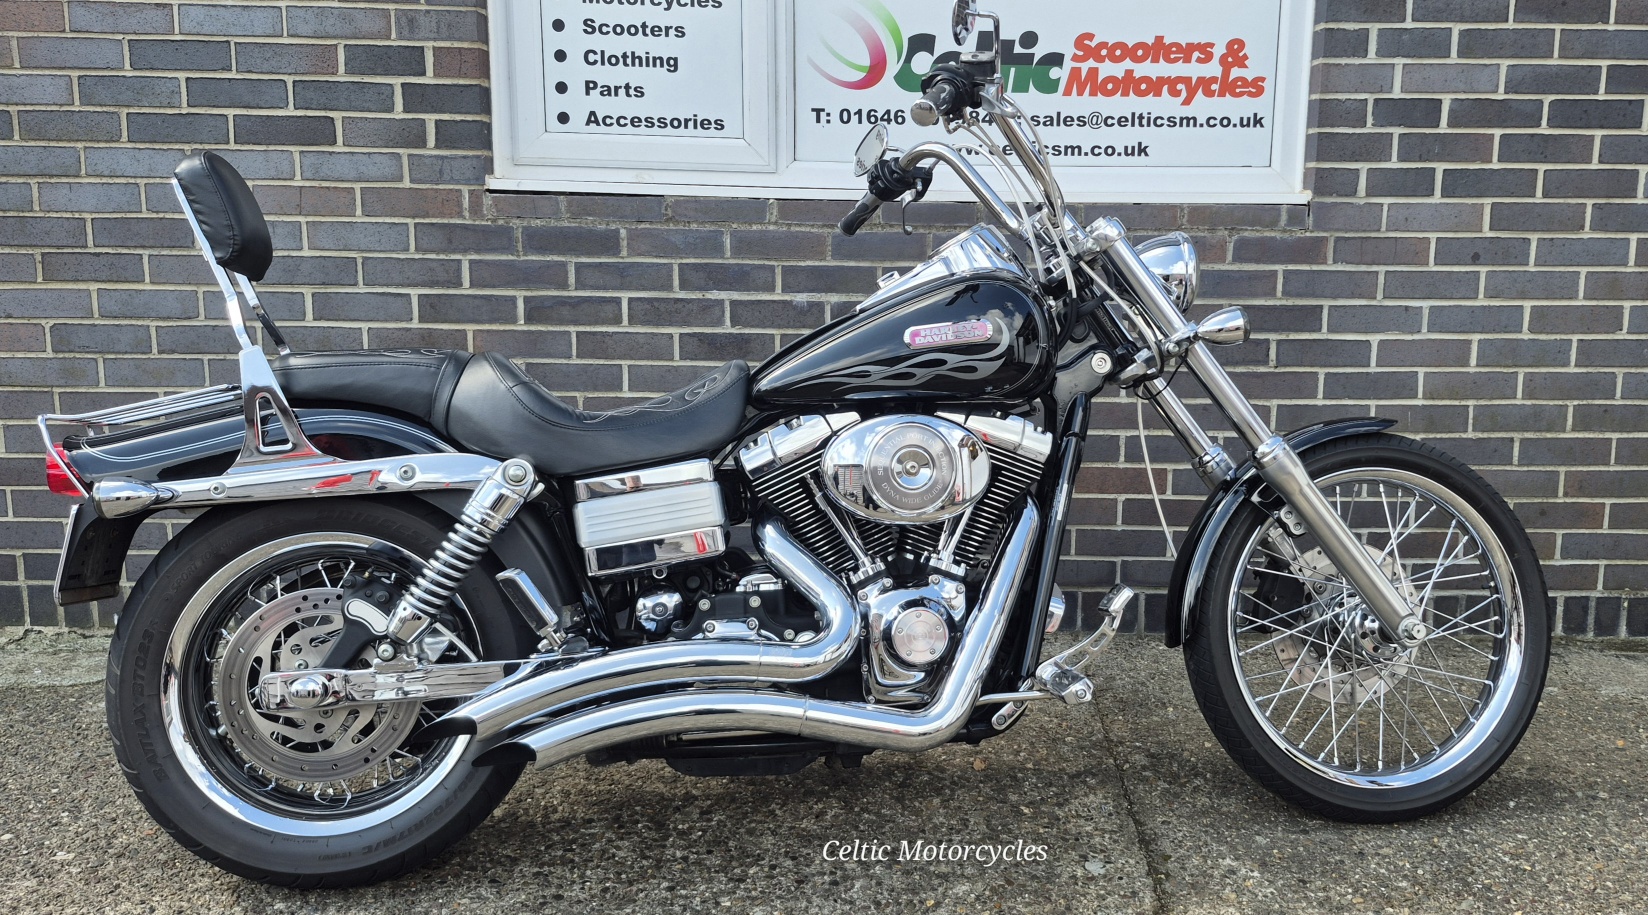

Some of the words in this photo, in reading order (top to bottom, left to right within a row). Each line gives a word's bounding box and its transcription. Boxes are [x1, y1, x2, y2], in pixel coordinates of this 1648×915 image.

[582, 18, 686, 38] Scooters
[583, 49, 679, 73] Clothing
[1070, 32, 1216, 64] Scooters
[1219, 38, 1249, 69] &
[584, 80, 645, 99] Parts
[1062, 66, 1267, 106] Motorcycles
[584, 110, 725, 131] Accessories
[811, 108, 831, 124] T:
[838, 108, 906, 125] 01646
[1030, 111, 1265, 130] sales@celticsm.co.uk
[915, 329, 984, 344] DAVIDSON
[906, 432, 928, 442] PORT
[881, 482, 900, 501] DYNA
[902, 496, 922, 504] WIDE
